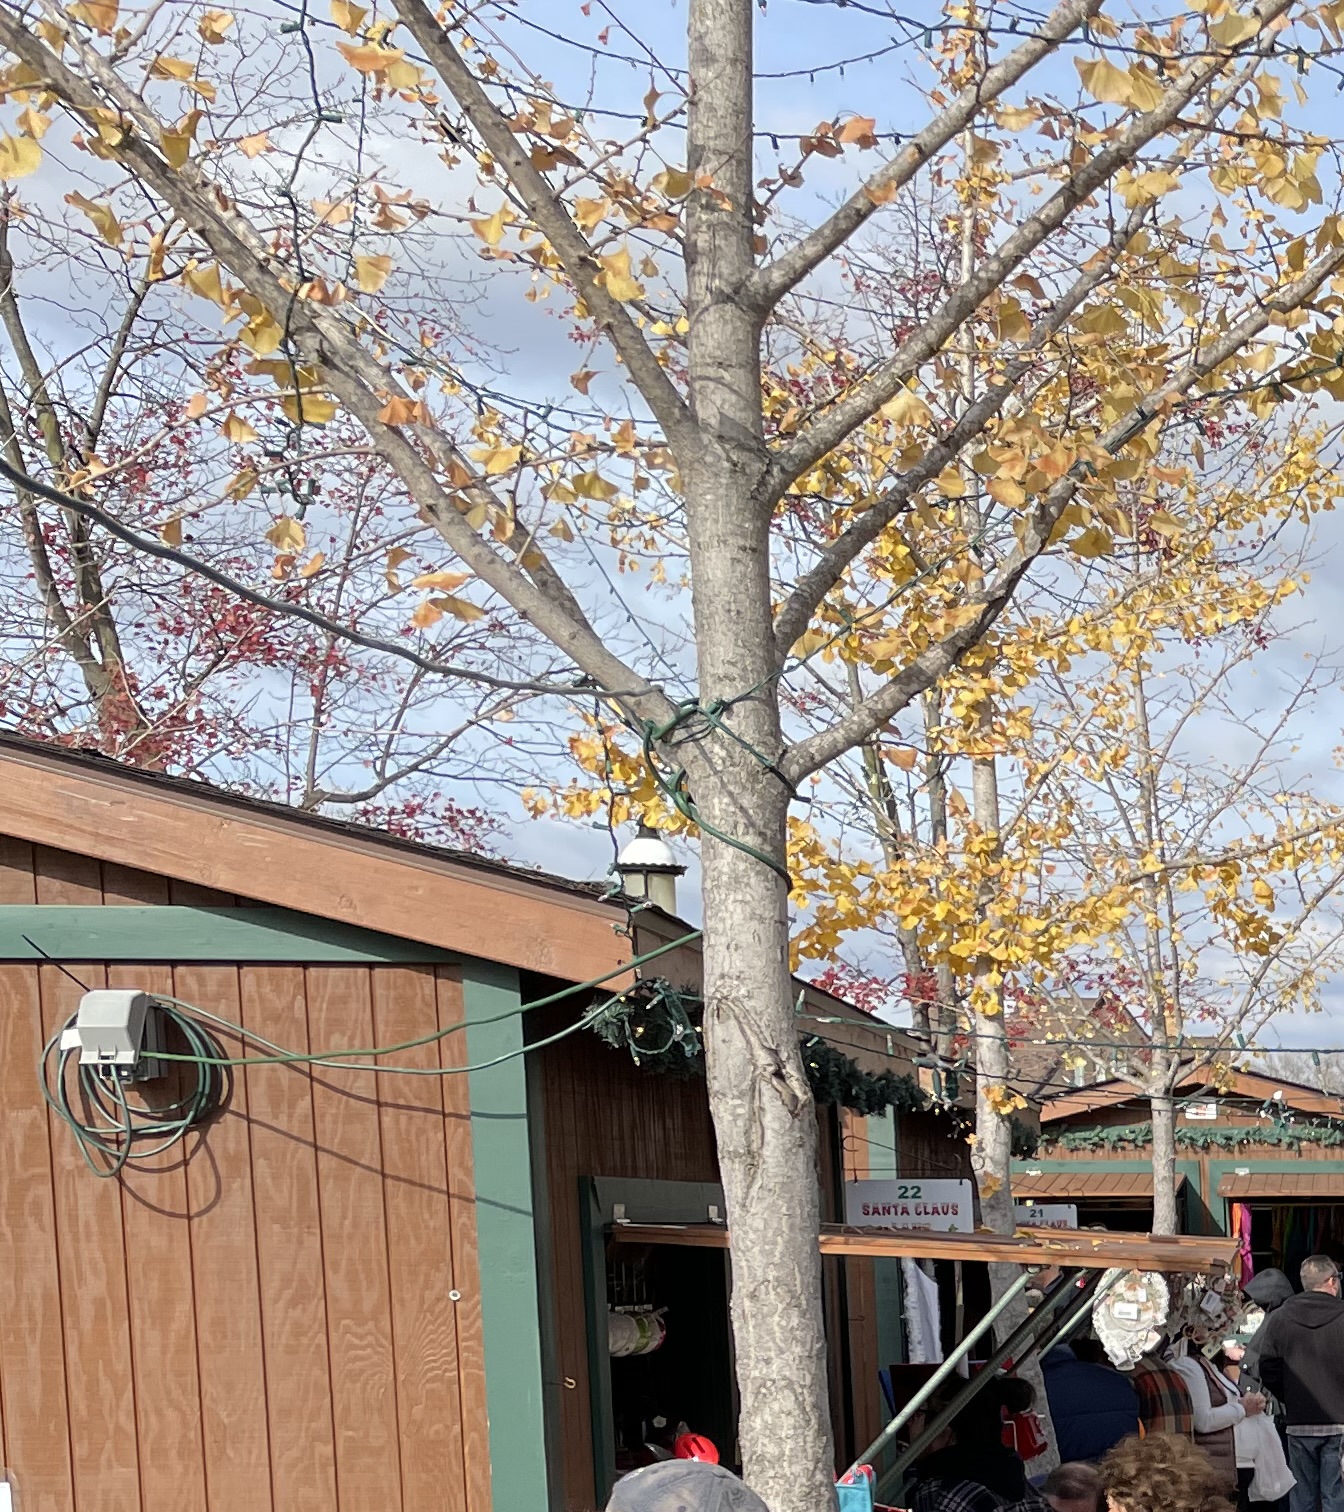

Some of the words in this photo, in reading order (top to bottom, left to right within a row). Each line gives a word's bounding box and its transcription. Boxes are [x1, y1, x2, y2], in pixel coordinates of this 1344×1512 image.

[897, 1184, 923, 1200] 22
[861, 1202, 911, 1217] SANTA
[914, 1202, 960, 1217] CLAUS
[1029, 1208, 1044, 1218] 21
